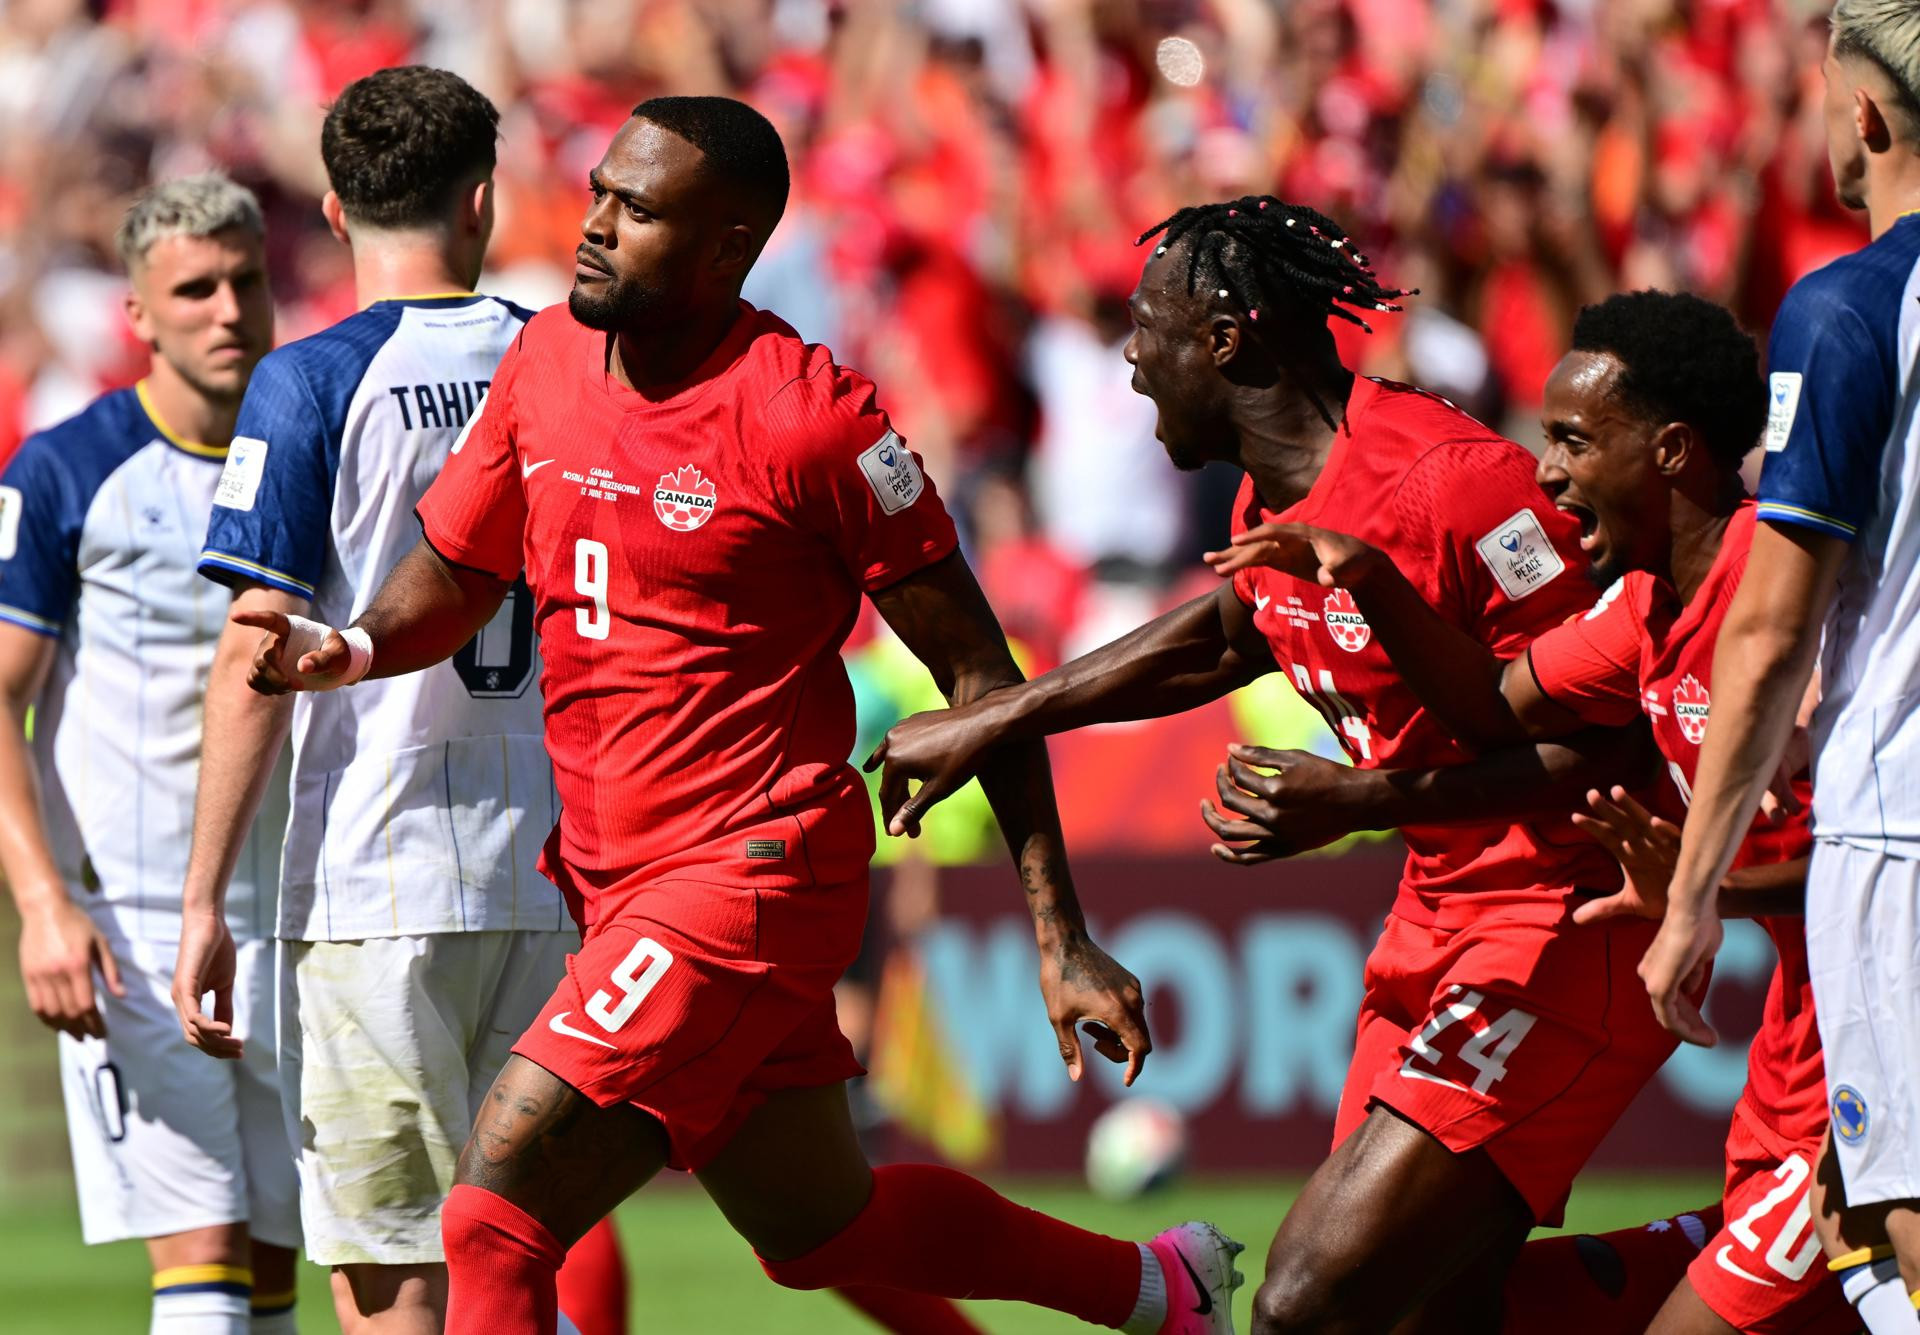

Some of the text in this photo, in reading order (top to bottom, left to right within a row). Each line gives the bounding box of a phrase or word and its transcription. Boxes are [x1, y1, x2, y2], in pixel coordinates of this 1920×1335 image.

[655, 490, 713, 509] CANADA
[892, 471, 913, 496] PEACE
[574, 538, 611, 641] 9
[1514, 556, 1543, 580] PEACE
[1527, 572, 1542, 584] FIFA
[1326, 613, 1366, 625] CANAD
[585, 937, 674, 1033] 9
[918, 908, 1380, 1122] WOR
[1410, 984, 1538, 1096] 24
[1728, 1153, 1823, 1282] 20
